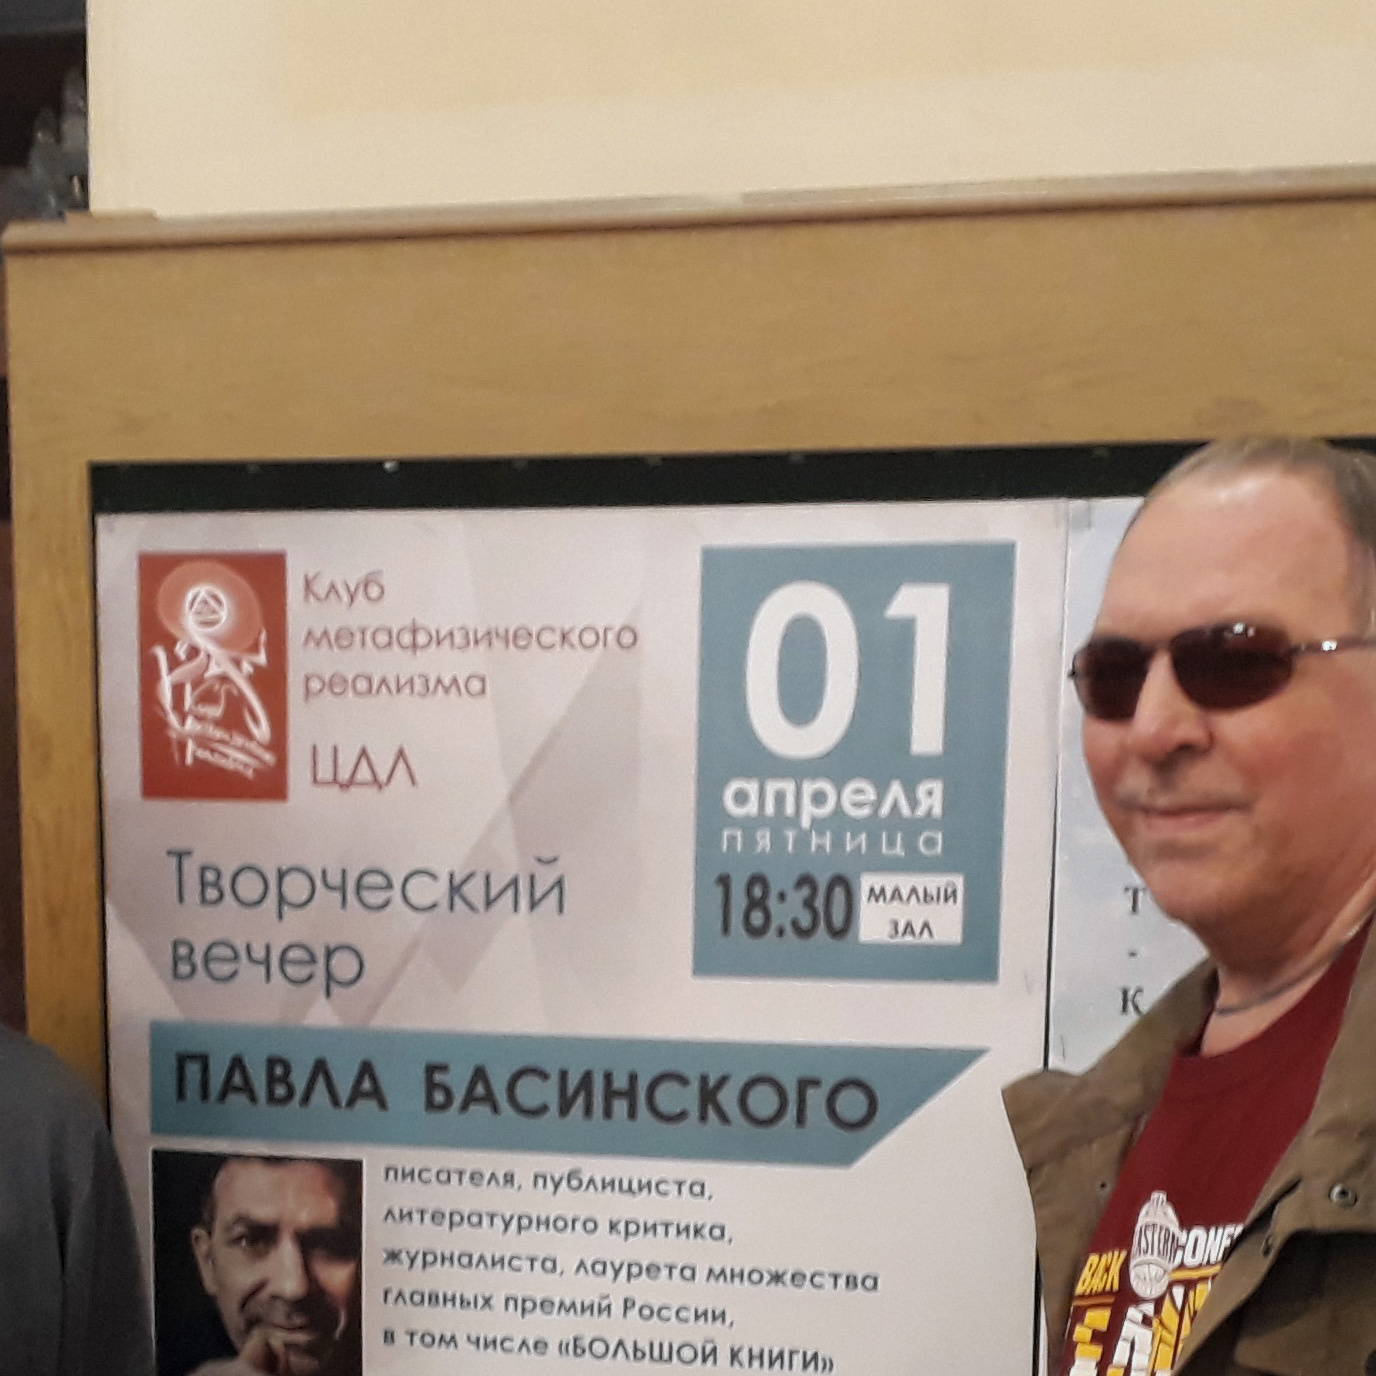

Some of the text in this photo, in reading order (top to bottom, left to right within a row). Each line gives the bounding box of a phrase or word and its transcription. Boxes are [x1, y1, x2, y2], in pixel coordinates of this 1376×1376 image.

[304, 570, 385, 605] Клуб
[303, 621, 637, 656] метафизического
[303, 671, 487, 702] реализма
[745, 579, 951, 760] 01
[310, 744, 418, 791] ЦДЛ
[723, 778, 944, 829] апреля
[721, 829, 944, 856] пятница
[167, 849, 567, 920] Творческий
[714, 872, 854, 940] 18:30
[866, 880, 958, 907] МАЛЫЙ
[888, 919, 934, 940] ЗАЛ
[171, 938, 364, 998] вечер
[175, 1053, 880, 1134] ПАВЛА БАСИНСКОГО
[384, 1164, 713, 1201] писателя, публициста,
[384, 1205, 734, 1246] литературного критика,
[383, 1247, 880, 1293] журналиста, лаурета множества
[1075, 1249, 1127, 1296] BACK
[383, 1288, 734, 1329] главных премий России,
[384, 1329, 834, 1374] в том числе «БОЛЬШОЙ КНИГИ»
